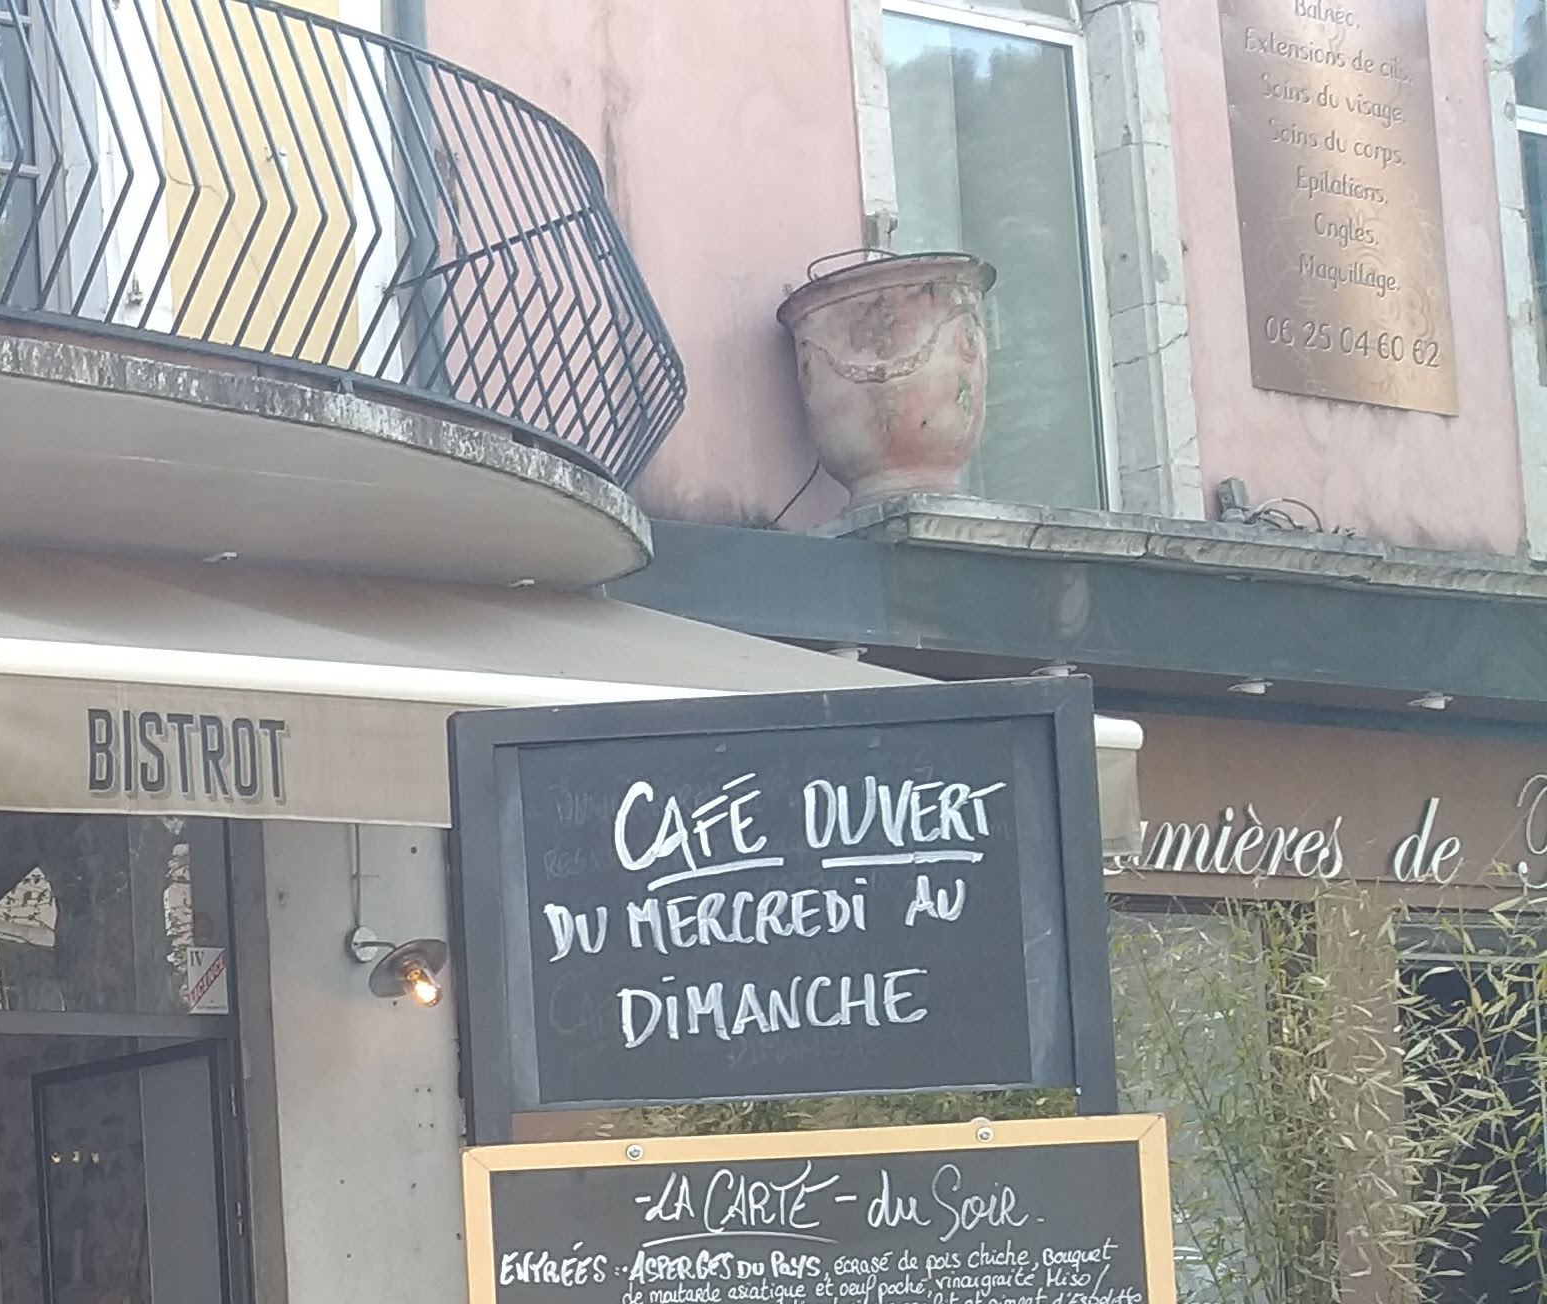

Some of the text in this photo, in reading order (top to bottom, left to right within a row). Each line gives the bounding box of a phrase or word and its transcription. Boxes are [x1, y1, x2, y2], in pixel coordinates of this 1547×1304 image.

[1245, 27, 1346, 68] Extensions
[1352, 50, 1374, 74] de
[1261, 73, 1310, 104] Soins
[1317, 84, 1339, 109] du
[1269, 118, 1318, 148] Soins
[1325, 130, 1346, 154] du
[1264, 316, 1440, 367] 06 25 04 60 62
[87, 708, 291, 806] BISTROT
[804, 776, 1006, 849] OUVERT
[1394, 797, 1464, 884] de
[545, 903, 606, 962] DU
[627, 878, 867, 954] MERCREDI
[906, 876, 965, 926] AU
[618, 969, 929, 1047] DIMANCHE
[868, 1169, 931, 1228] du
[736, 1260, 765, 1280] DU
[926, 1252, 961, 1280] pois
